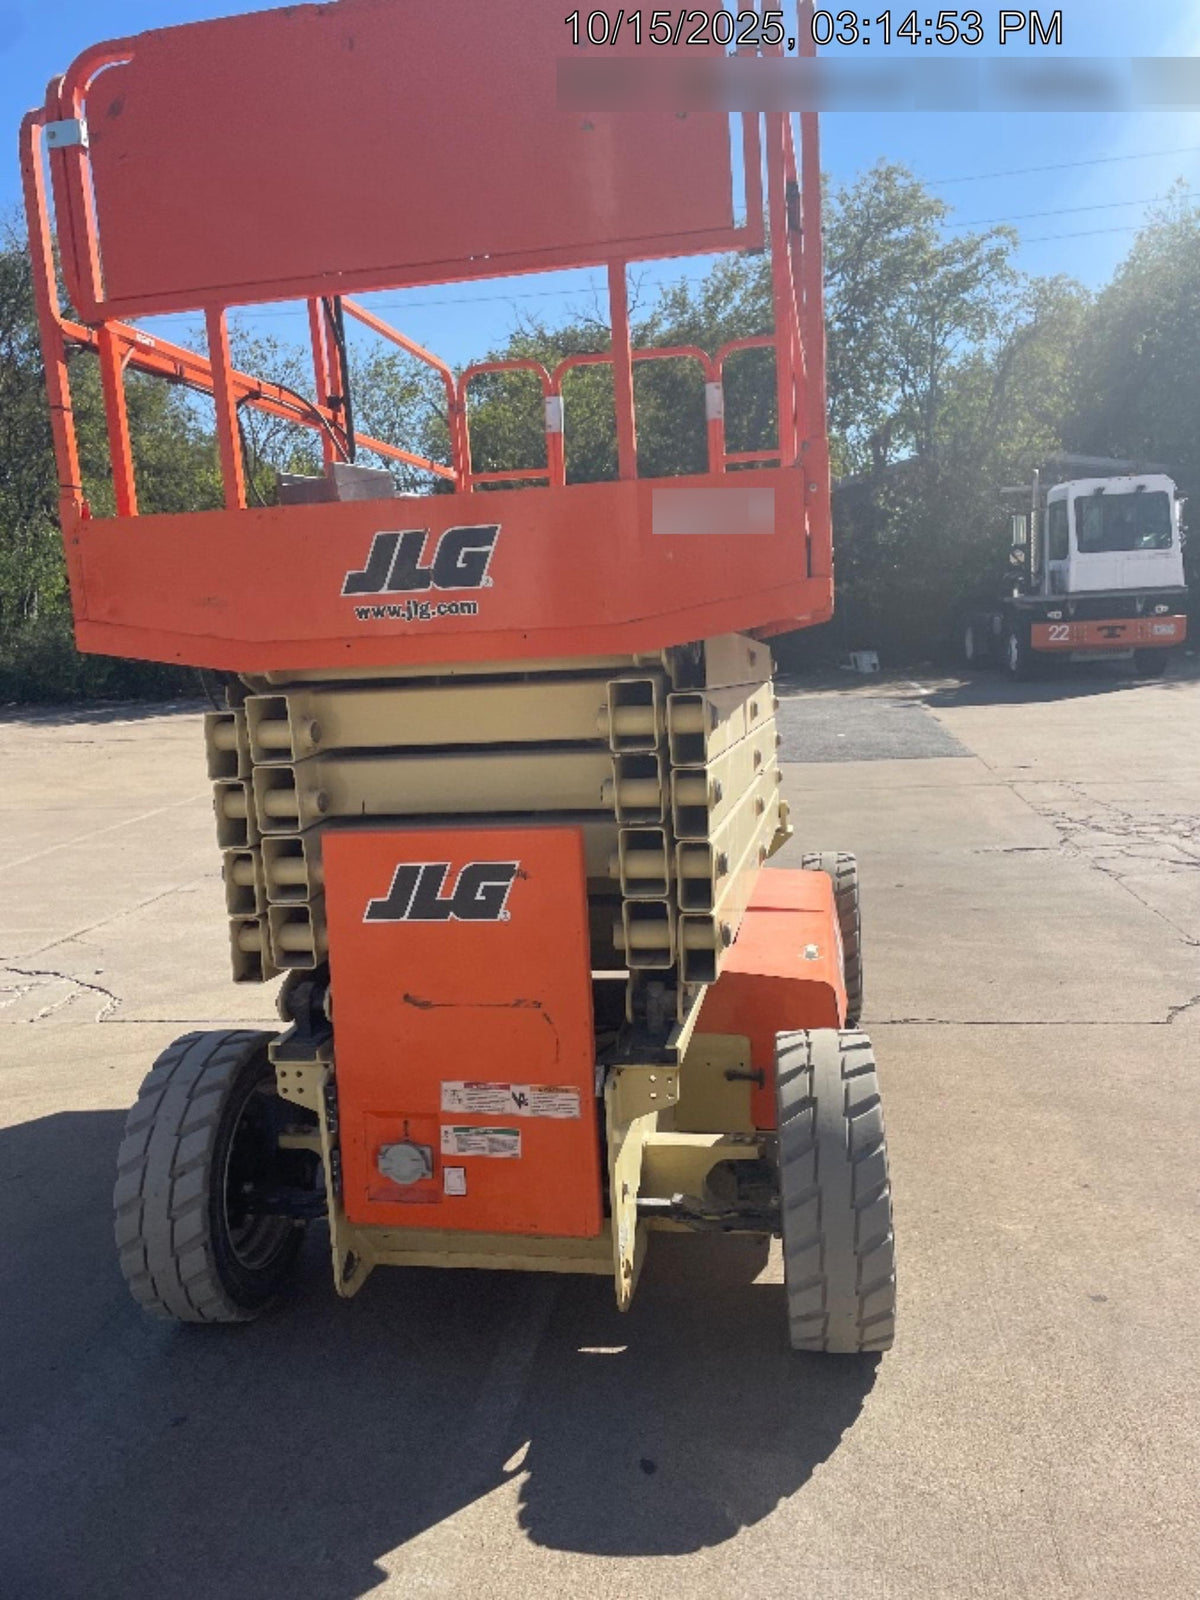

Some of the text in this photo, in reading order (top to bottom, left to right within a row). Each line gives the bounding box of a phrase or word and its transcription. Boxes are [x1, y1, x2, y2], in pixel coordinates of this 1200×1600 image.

[341, 524, 501, 596] JLG
[354, 600, 478, 621] www.jlg.com
[1048, 624, 1070, 641] 22
[363, 860, 521, 923] JLG
